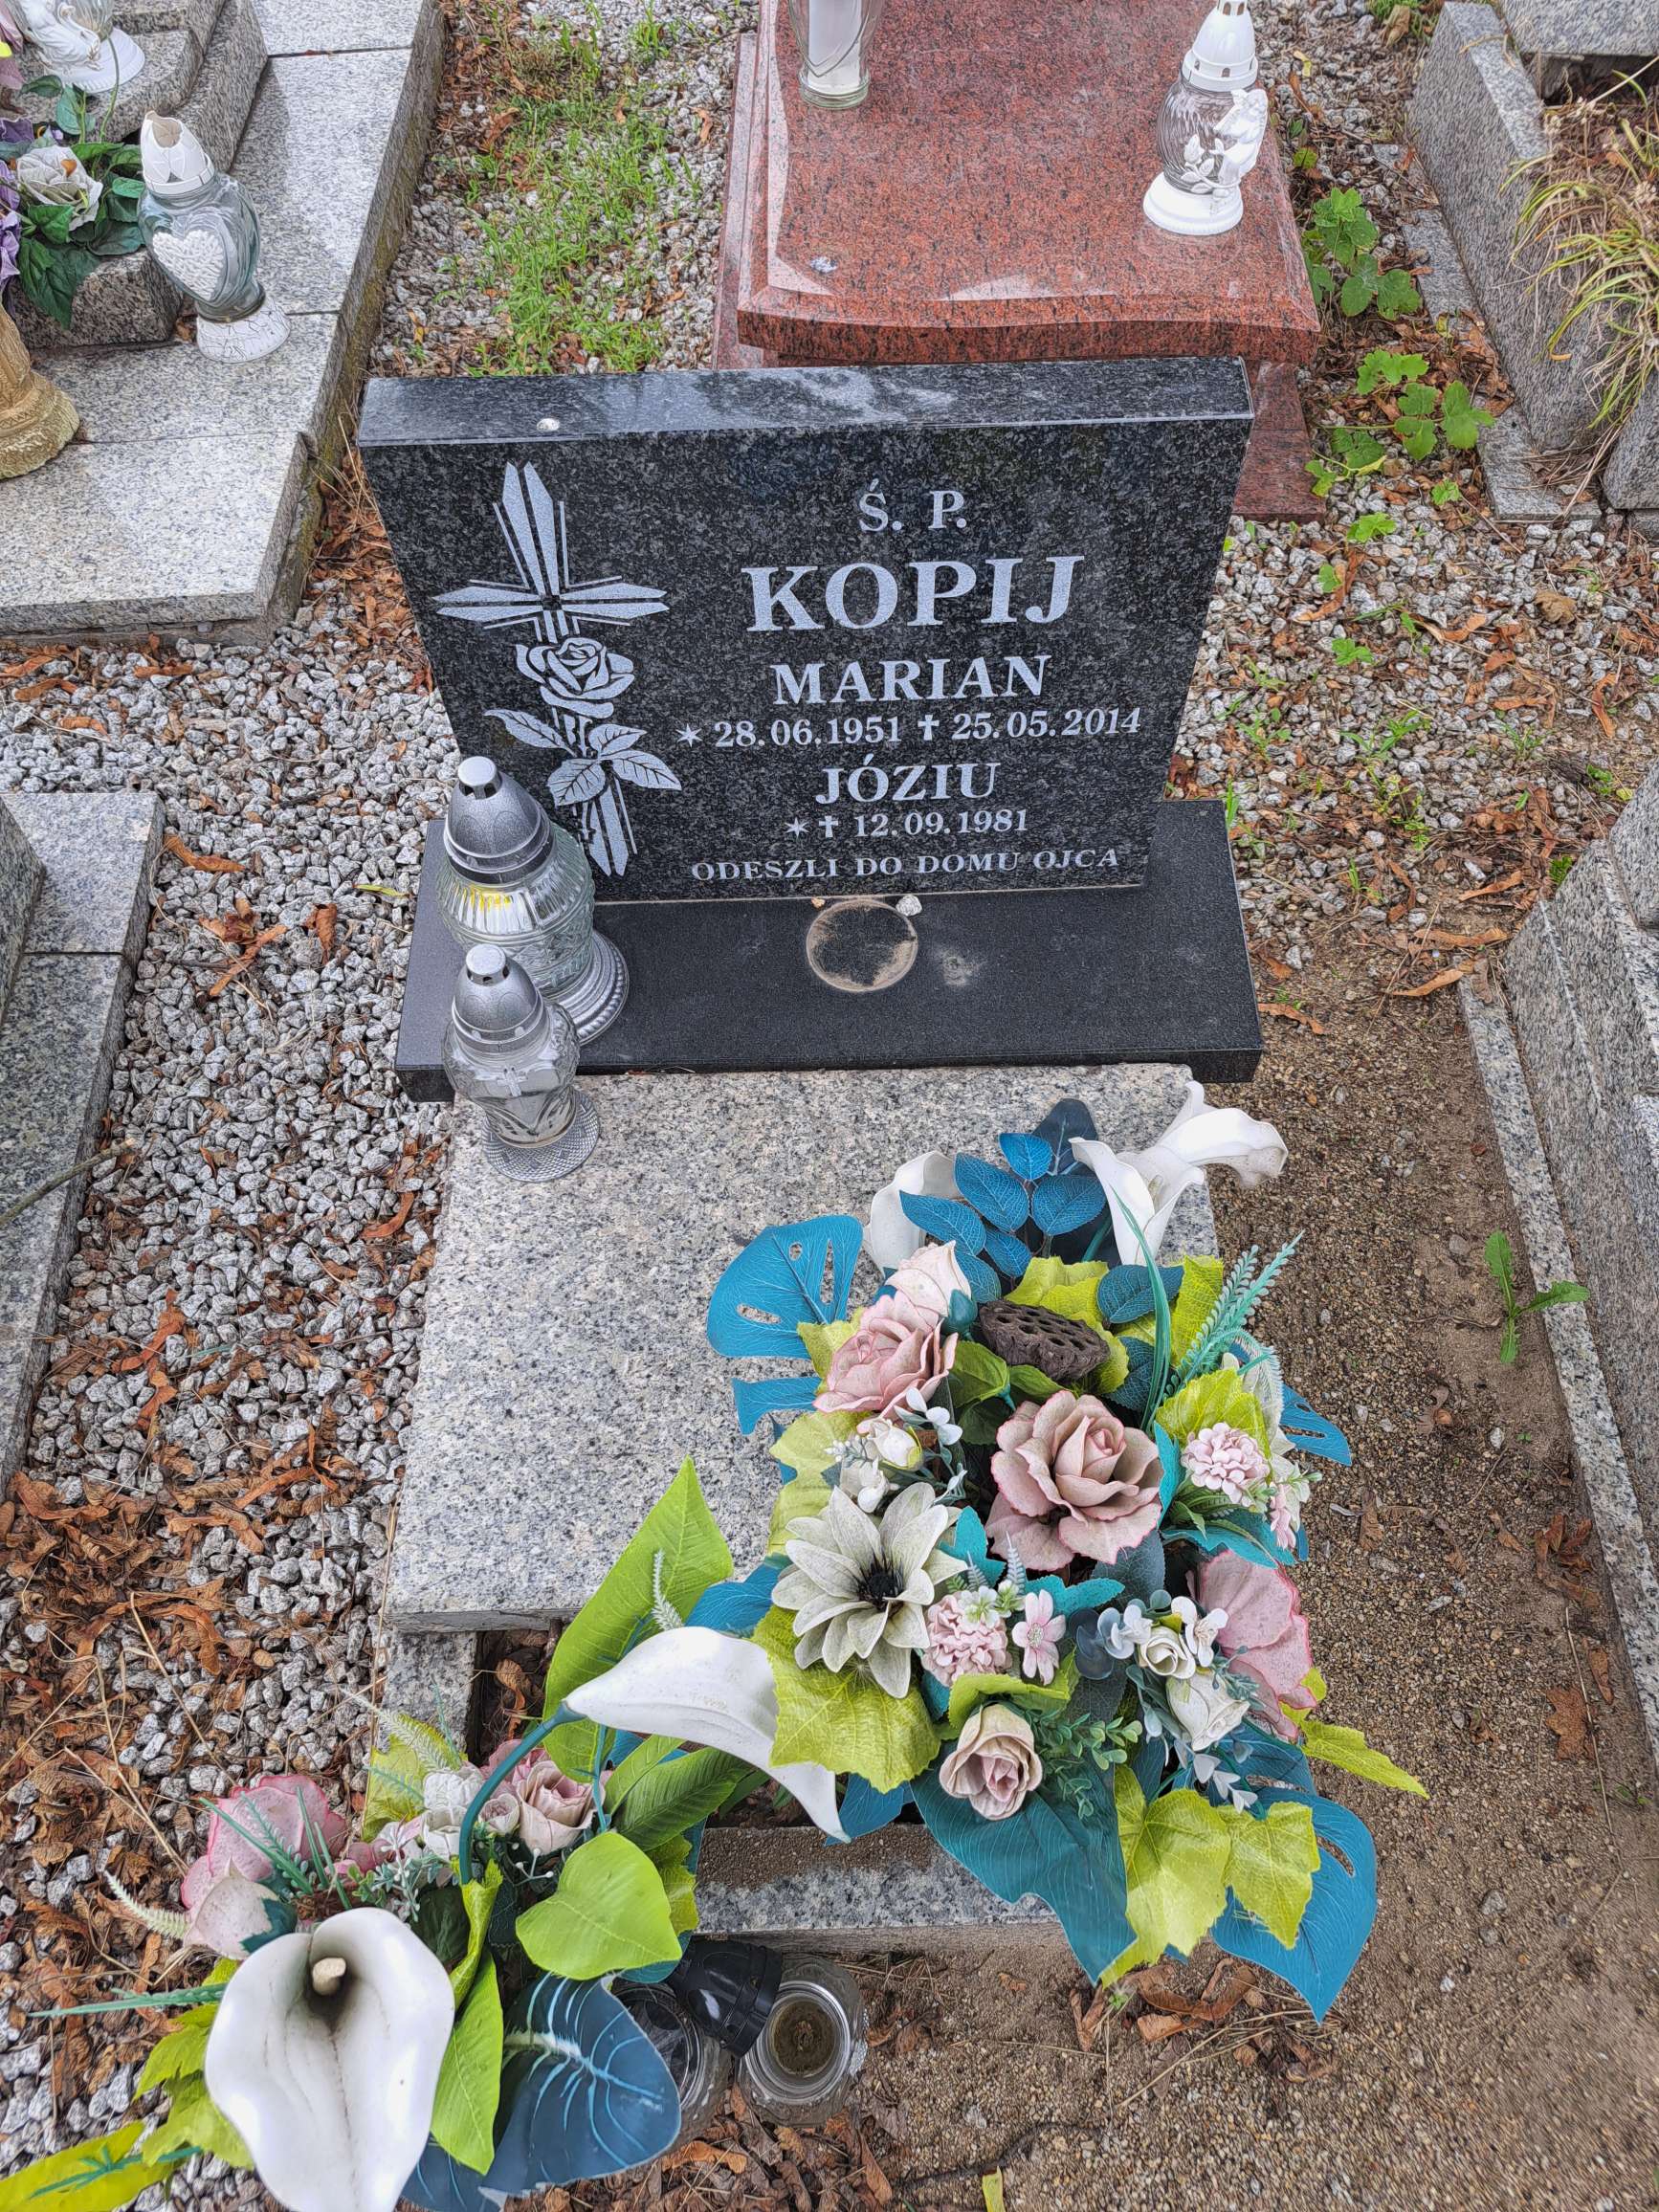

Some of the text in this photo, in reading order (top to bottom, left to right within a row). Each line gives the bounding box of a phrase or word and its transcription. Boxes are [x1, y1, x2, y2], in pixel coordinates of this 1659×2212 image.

[859, 478, 967, 532] Ś. P.
[741, 555, 1085, 631] KOPIJ
[769, 654, 1051, 705] MARIAN
[714, 707, 1141, 747] 28.06.1951 25.05.2014
[815, 754, 1001, 805] JÓZIU
[854, 808, 1028, 837] 12.09.1981
[691, 848, 1118, 881] ODESZLI DO DOMU OJCA
